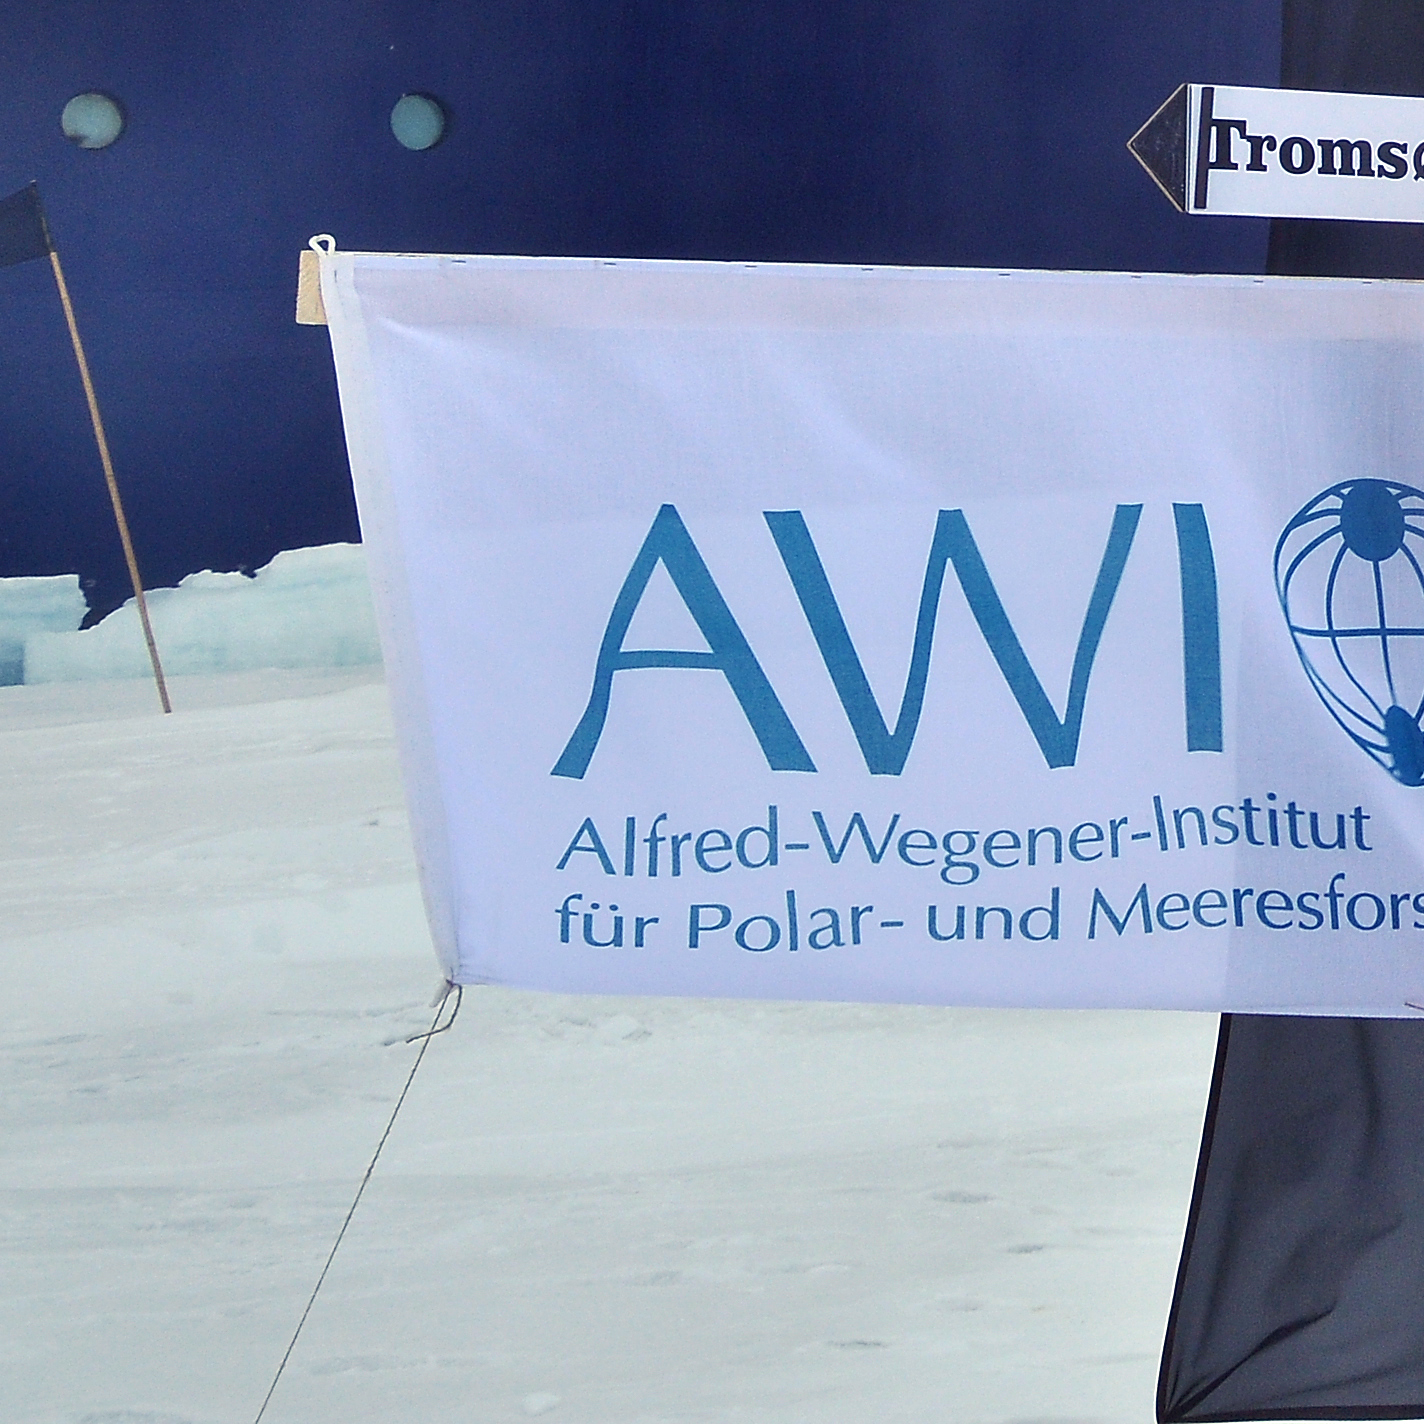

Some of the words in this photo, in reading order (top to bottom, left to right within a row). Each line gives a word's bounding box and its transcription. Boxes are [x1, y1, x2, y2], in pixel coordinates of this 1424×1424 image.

[549, 501, 1224, 778] AWI
[555, 792, 1373, 886] Alfred-Wegener-Institut
[555, 893, 659, 948] für
[688, 889, 904, 952] Polar-
[927, 886, 1060, 941] und
